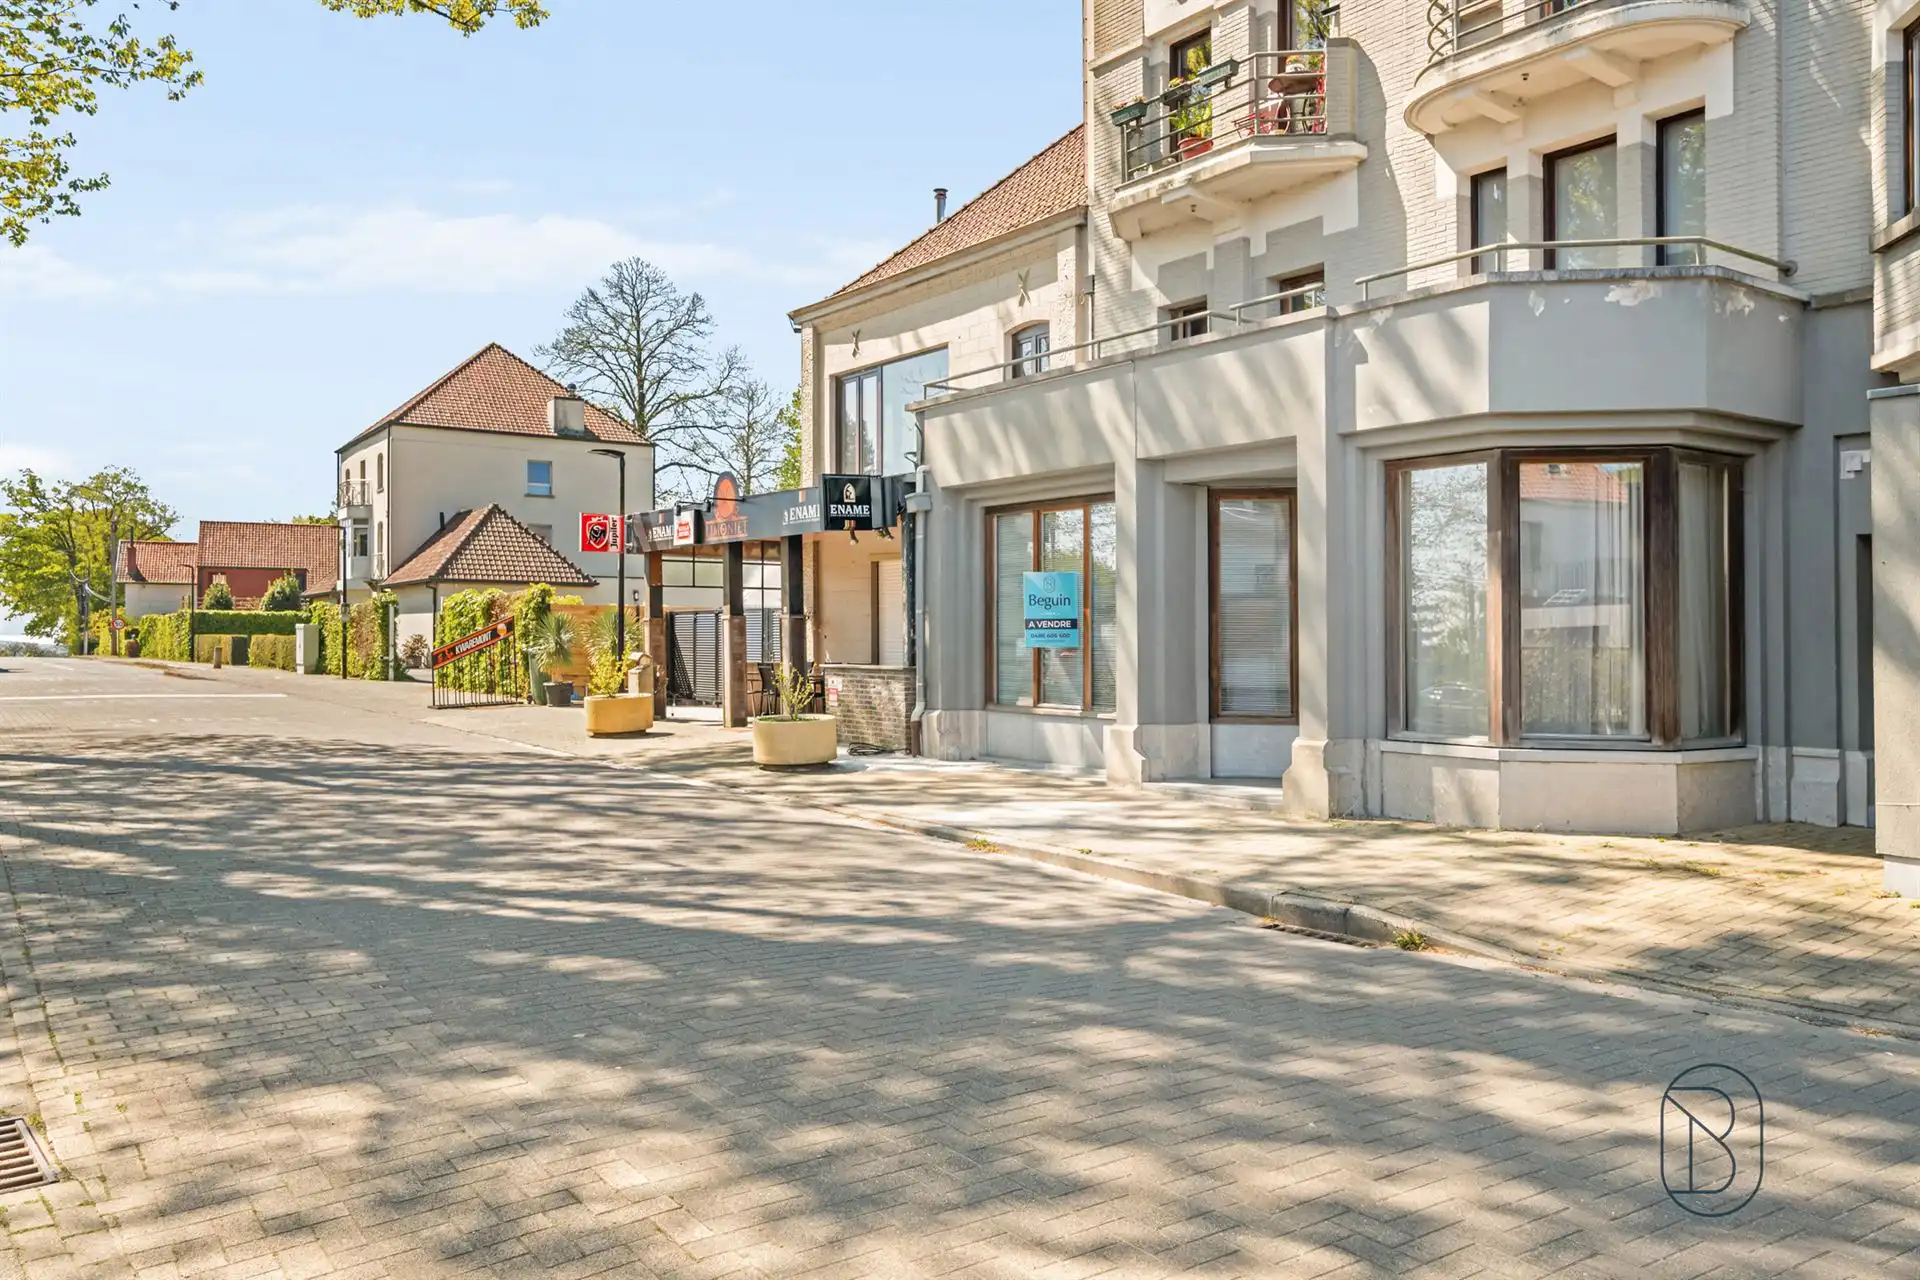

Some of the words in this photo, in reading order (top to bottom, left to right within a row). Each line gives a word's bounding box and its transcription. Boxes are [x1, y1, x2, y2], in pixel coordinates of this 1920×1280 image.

[830, 504, 870, 515] ENAME
[610, 517, 619, 549] Jupiler
[1028, 594, 1071, 610] Beguin
[1036, 620, 1072, 628] VENDRE
[455, 630, 492, 655] KWAREMONT
